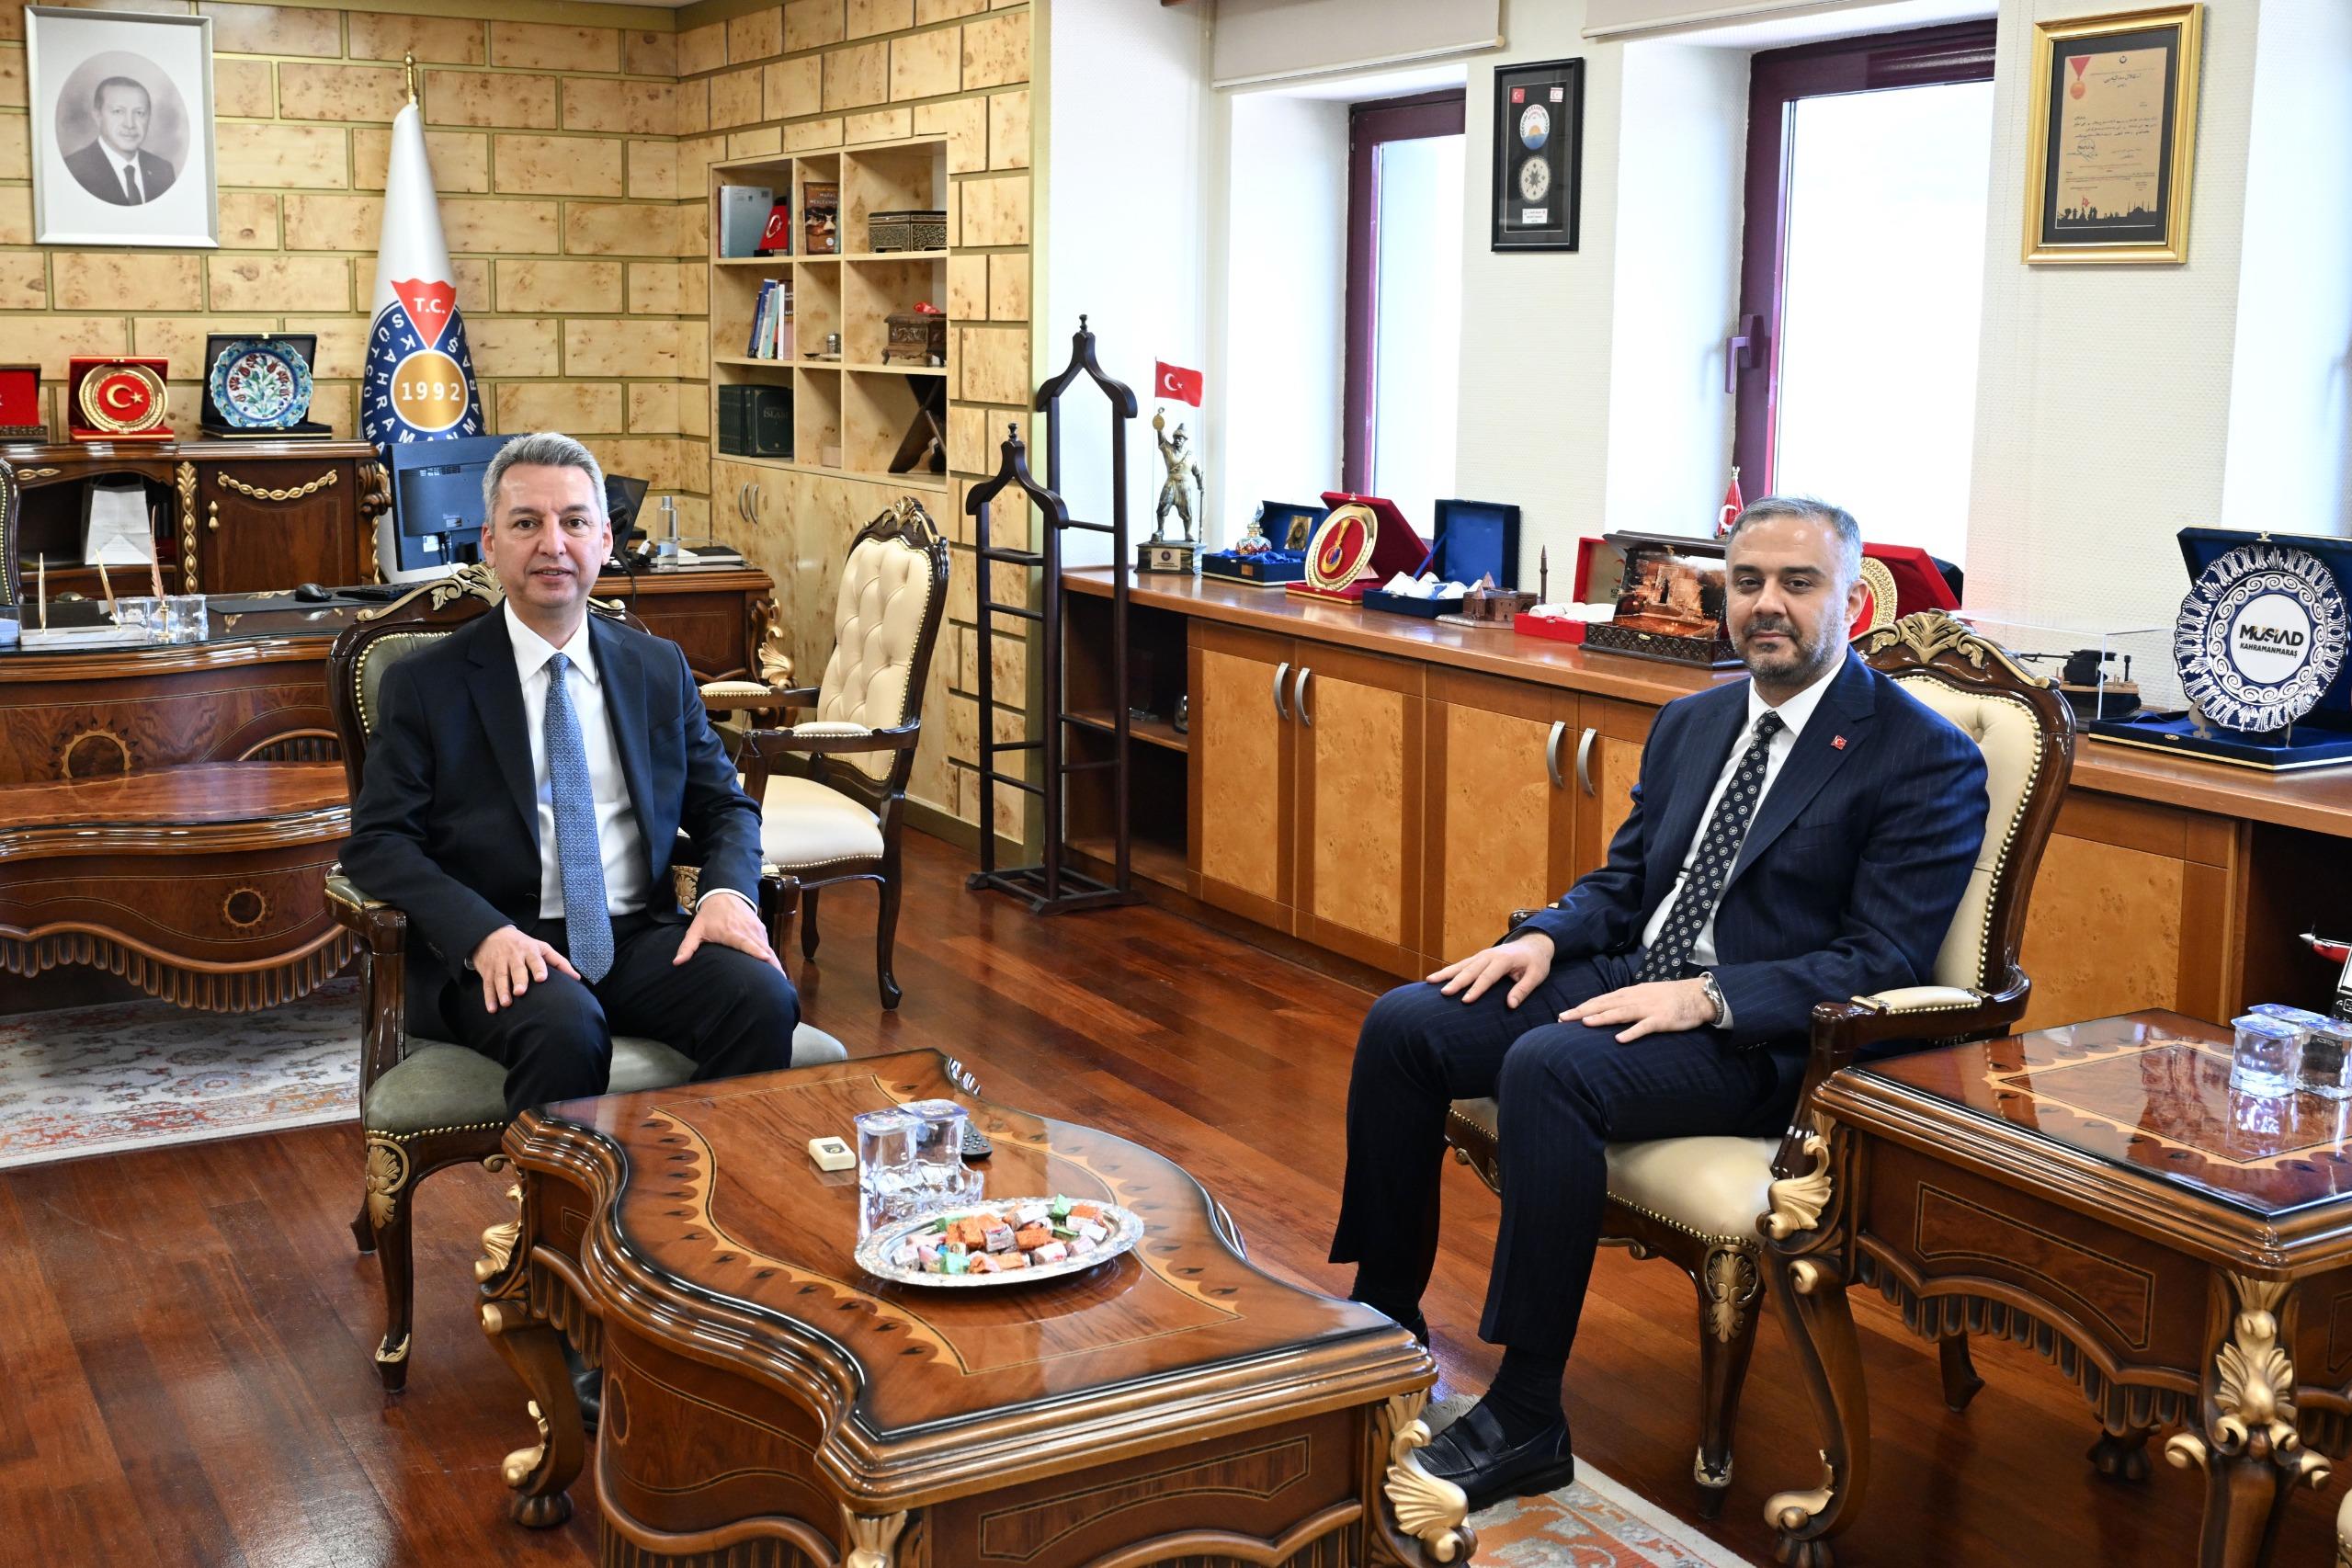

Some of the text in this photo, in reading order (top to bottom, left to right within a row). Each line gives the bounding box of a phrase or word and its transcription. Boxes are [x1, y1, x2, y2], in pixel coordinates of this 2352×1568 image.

[414, 298, 446, 313] T.C.
[402, 381, 460, 401] 1992
[2240, 642, 2299, 659] KAHRAMANMARAŞ
